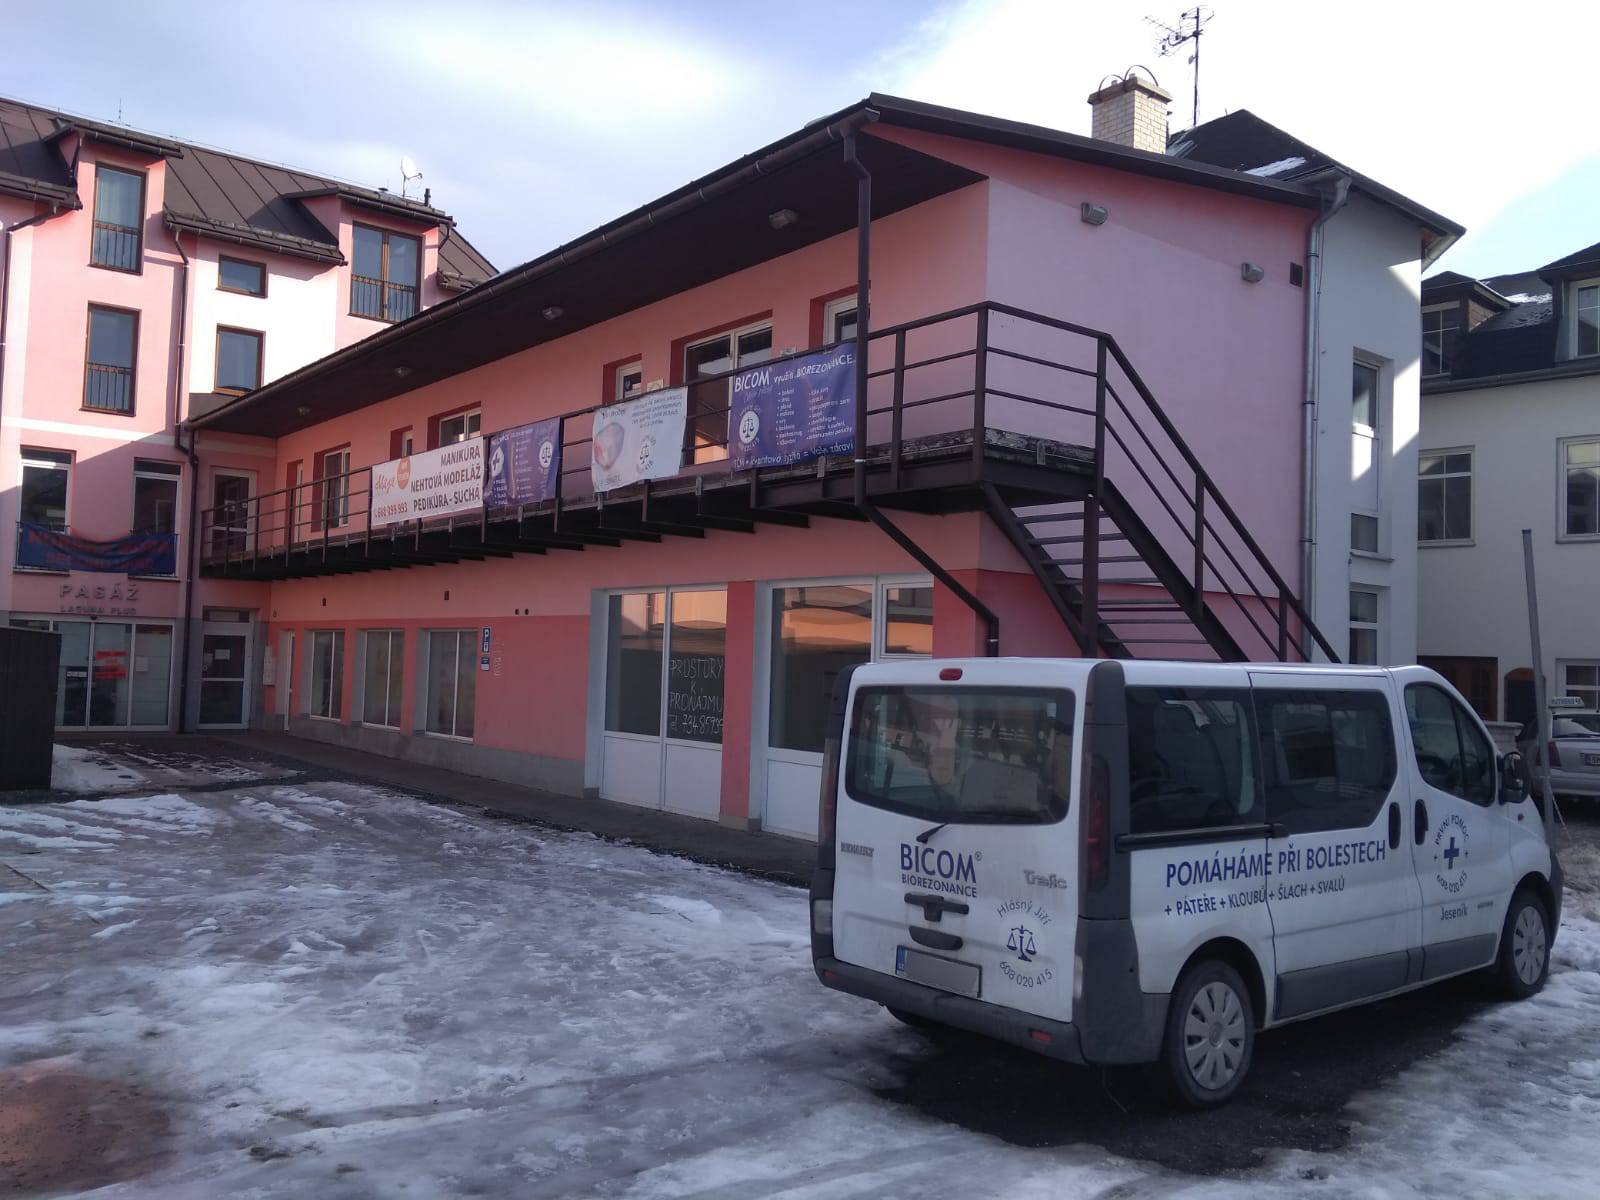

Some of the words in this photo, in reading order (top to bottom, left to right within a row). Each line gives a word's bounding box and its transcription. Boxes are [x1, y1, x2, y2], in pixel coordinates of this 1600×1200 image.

[734, 369, 770, 392] BICOM
[411, 471, 442, 494] NEHTOVÁ
[444, 463, 481, 485] MODELÁŽ
[453, 484, 480, 504] SUCHÁ
[1166, 847, 1273, 888] POMÁHÁME
[1278, 842, 1300, 874] PŘI
[1306, 839, 1386, 871] BOLESTECH
[901, 873, 977, 898] BIOREZONANCE
[997, 900, 1033, 918] Hlásný
[1176, 893, 1217, 916] PÁTEŘE
[1278, 883, 1308, 901] ŠLACH
[1000, 961, 1016, 980] 608
[1016, 974, 1034, 988] 020
[1036, 968, 1053, 985] 415
